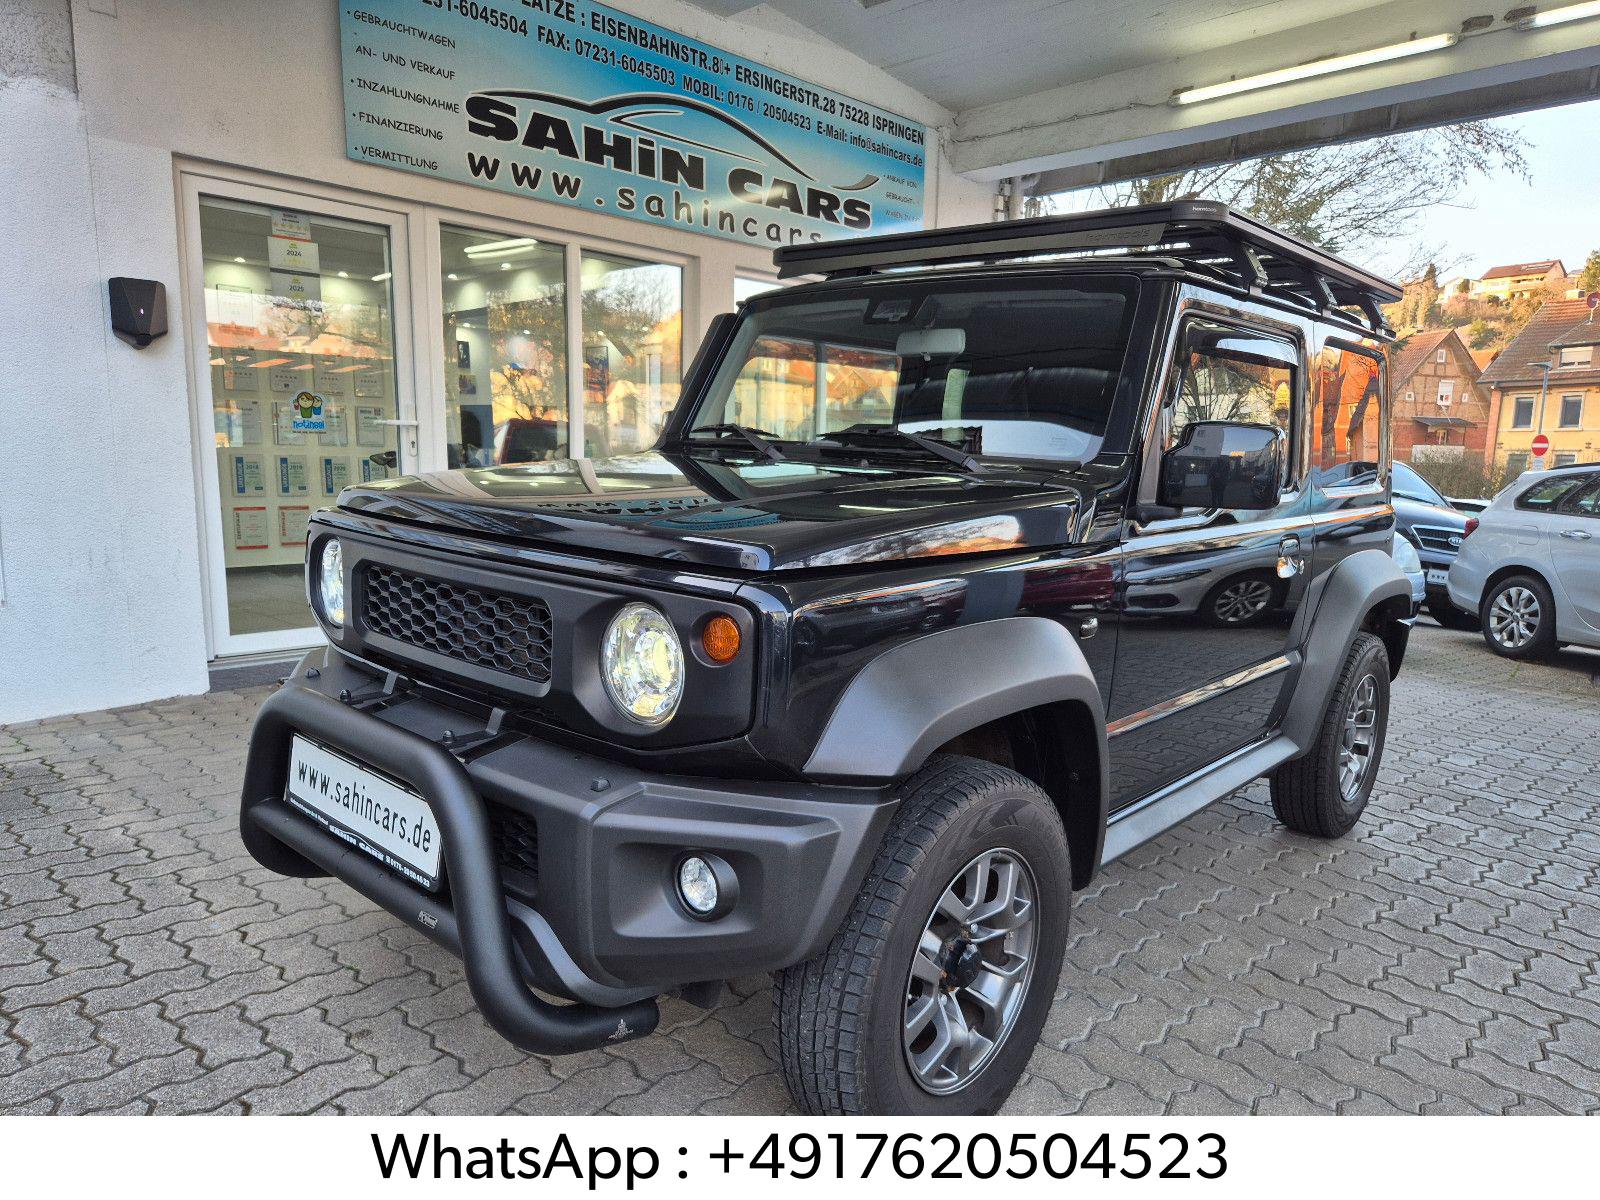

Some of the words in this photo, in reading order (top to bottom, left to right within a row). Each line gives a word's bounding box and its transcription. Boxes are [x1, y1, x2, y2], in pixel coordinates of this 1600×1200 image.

[353, 10, 456, 49] GEBRAUCHTWAGEN
[355, 45, 377, 58] AN-
[382, 51, 406, 67] UND
[410, 59, 456, 80] VERKAUF
[356, 77, 460, 113] INZAHLUNGNAHME
[422, 0, 528, 37] 1-6045504
[537, 24, 571, 51] FAX:
[575, 38, 676, 86] 07231-6045503
[682, 75, 724, 102] MOBIL:
[727, 90, 754, 112] 0176
[763, 102, 811, 131] 20504523
[816, 120, 848, 142] E-Mail:
[850, 131, 924, 167] info@sahincars.de
[735, 64, 836, 115] ERSINGERSTR.28
[839, 101, 870, 127] 75228
[872, 114, 924, 145] ISPRINGEN
[358, 111, 444, 140] FINANZIERUNG
[360, 145, 438, 171] VERMITTLUNG
[728, 168, 871, 230] CARS
[298, 760, 431, 853] www.sahincars.de
